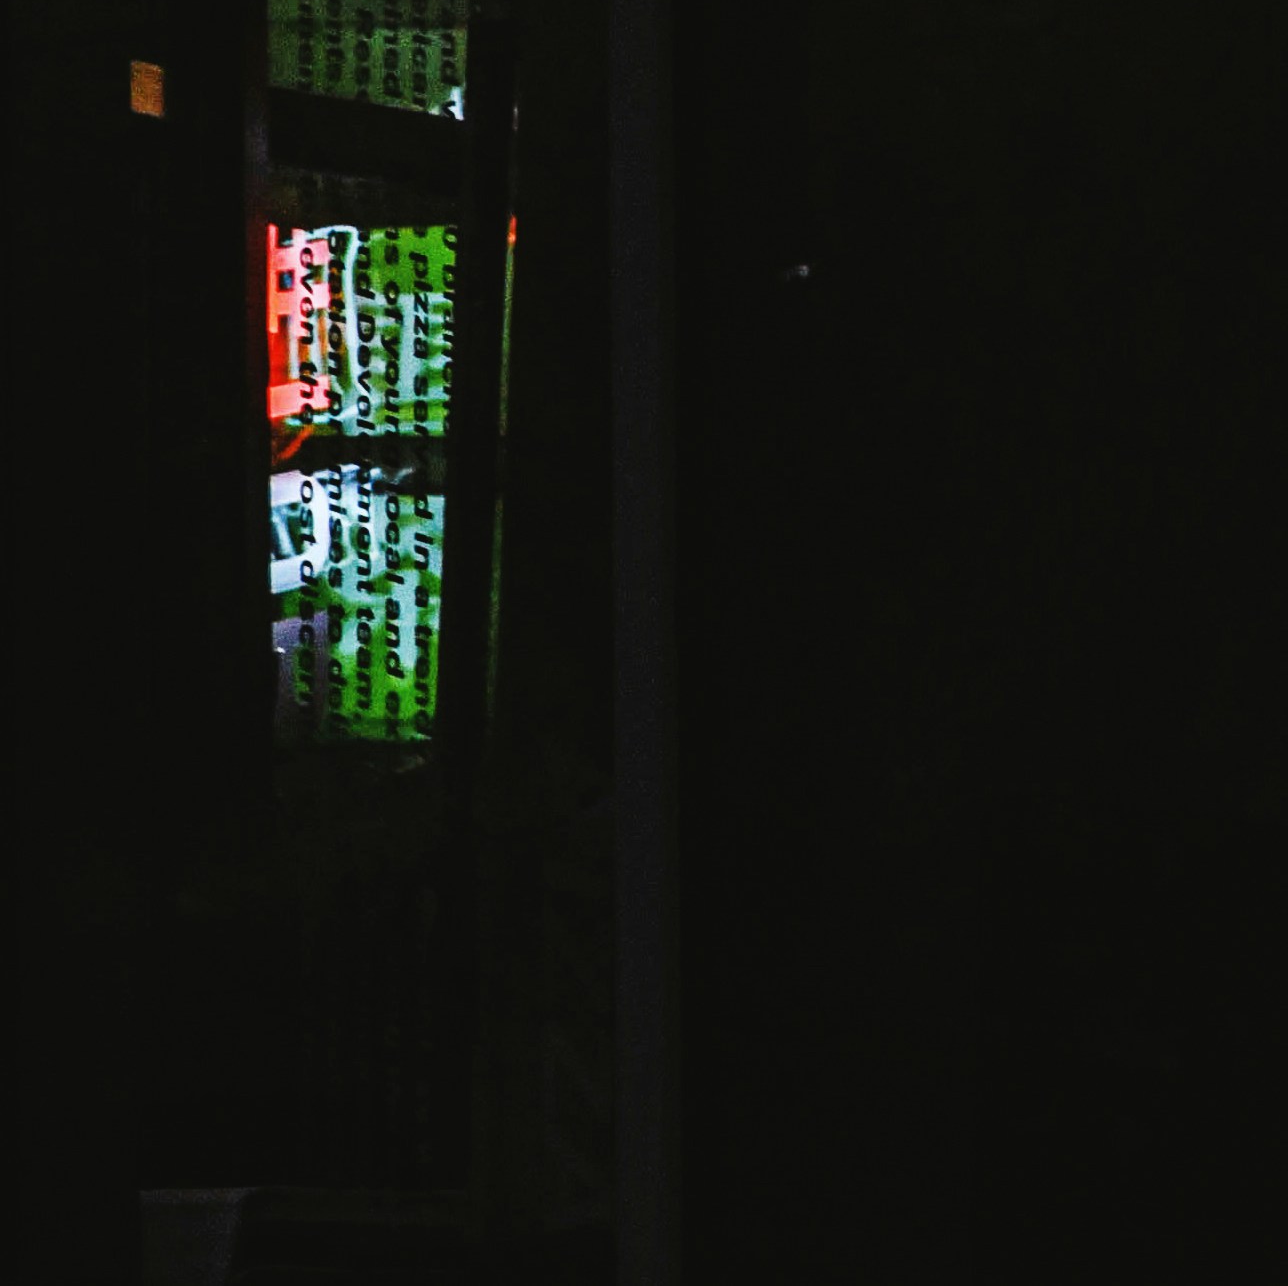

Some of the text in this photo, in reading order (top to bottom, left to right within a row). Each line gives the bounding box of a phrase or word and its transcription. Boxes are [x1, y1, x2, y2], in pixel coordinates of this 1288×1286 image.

[298, 246, 314, 345] even
[327, 231, 347, 376] Station
[383, 281, 402, 325] of
[408, 253, 428, 358] pizza
[412, 532, 432, 570] in
[327, 604, 343, 645] to
[382, 597, 402, 679] and
[413, 587, 428, 609] a
[413, 624, 431, 739] trend
